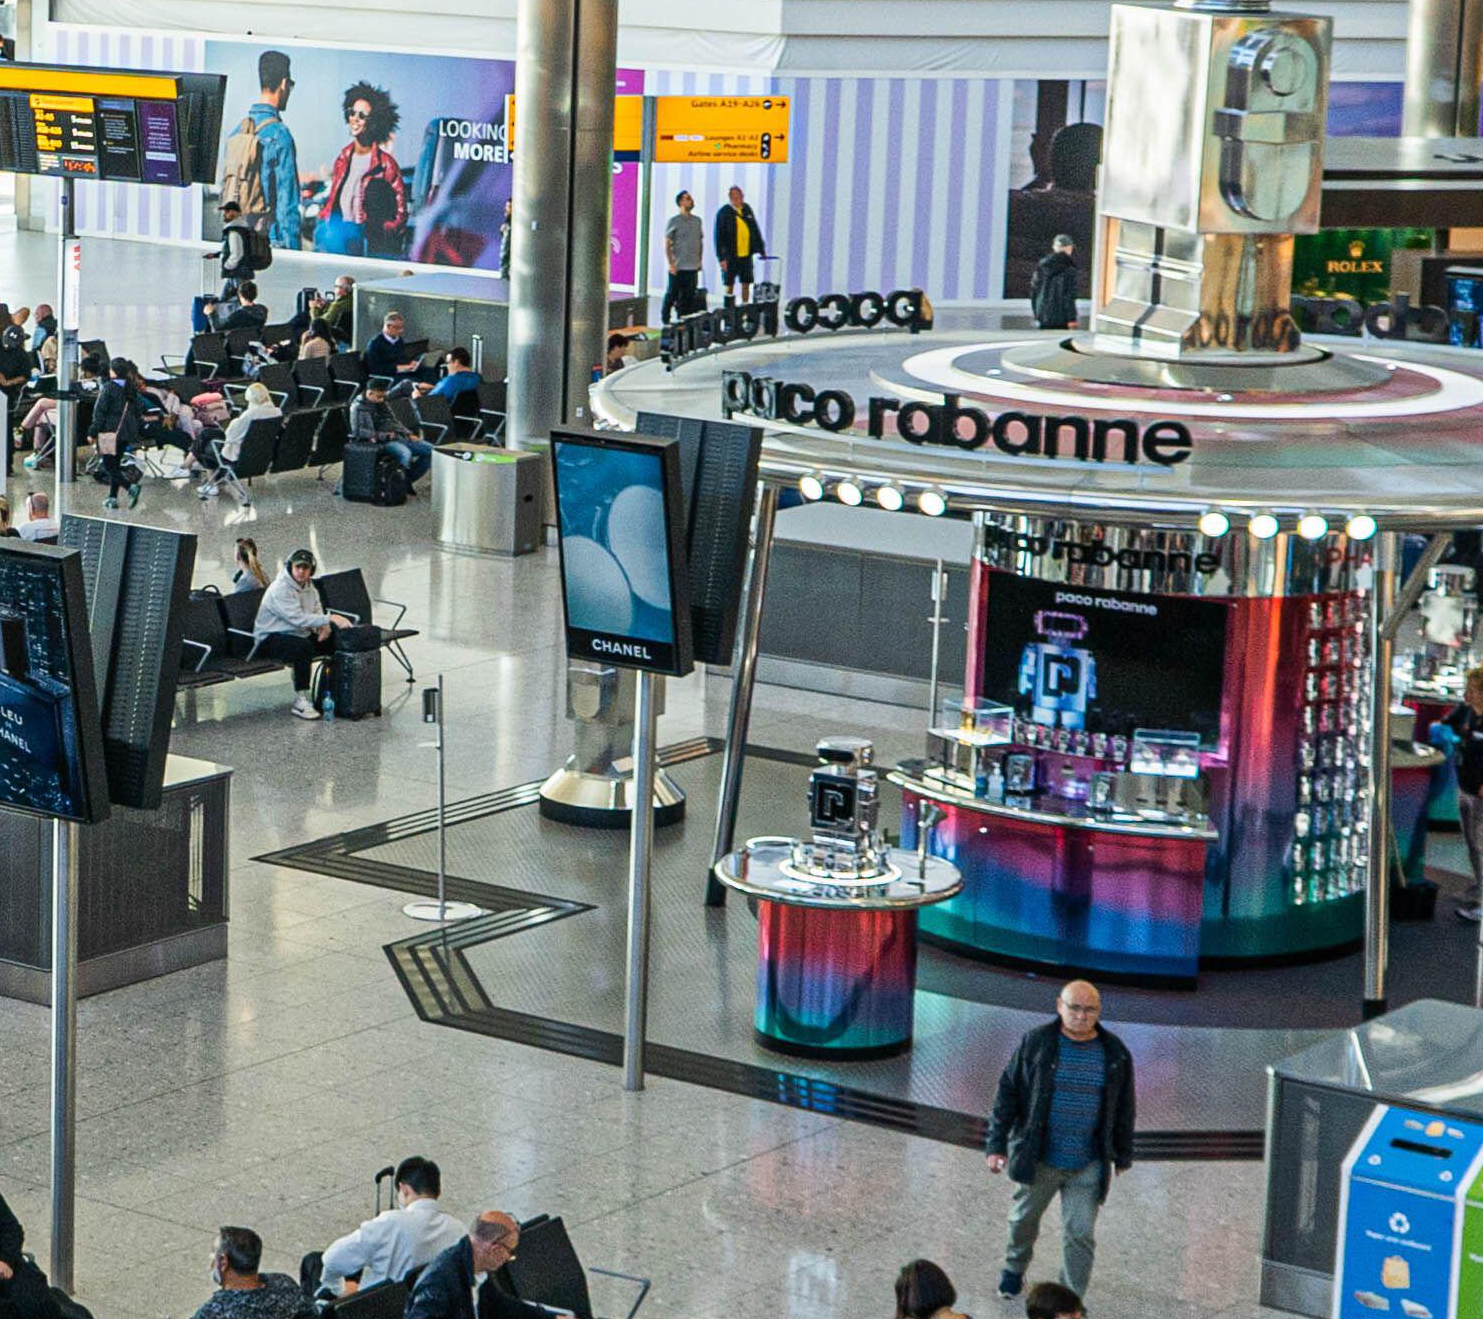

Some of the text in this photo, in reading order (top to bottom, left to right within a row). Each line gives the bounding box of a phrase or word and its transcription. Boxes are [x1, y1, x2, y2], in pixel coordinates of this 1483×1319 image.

[1327, 260, 1382, 273] ROLEX
[722, 369, 1194, 465] paco rabanne
[1052, 538, 1221, 574] rabanne
[1055, 592, 1158, 616] paco rabanne
[592, 638, 652, 660] CHANEL
